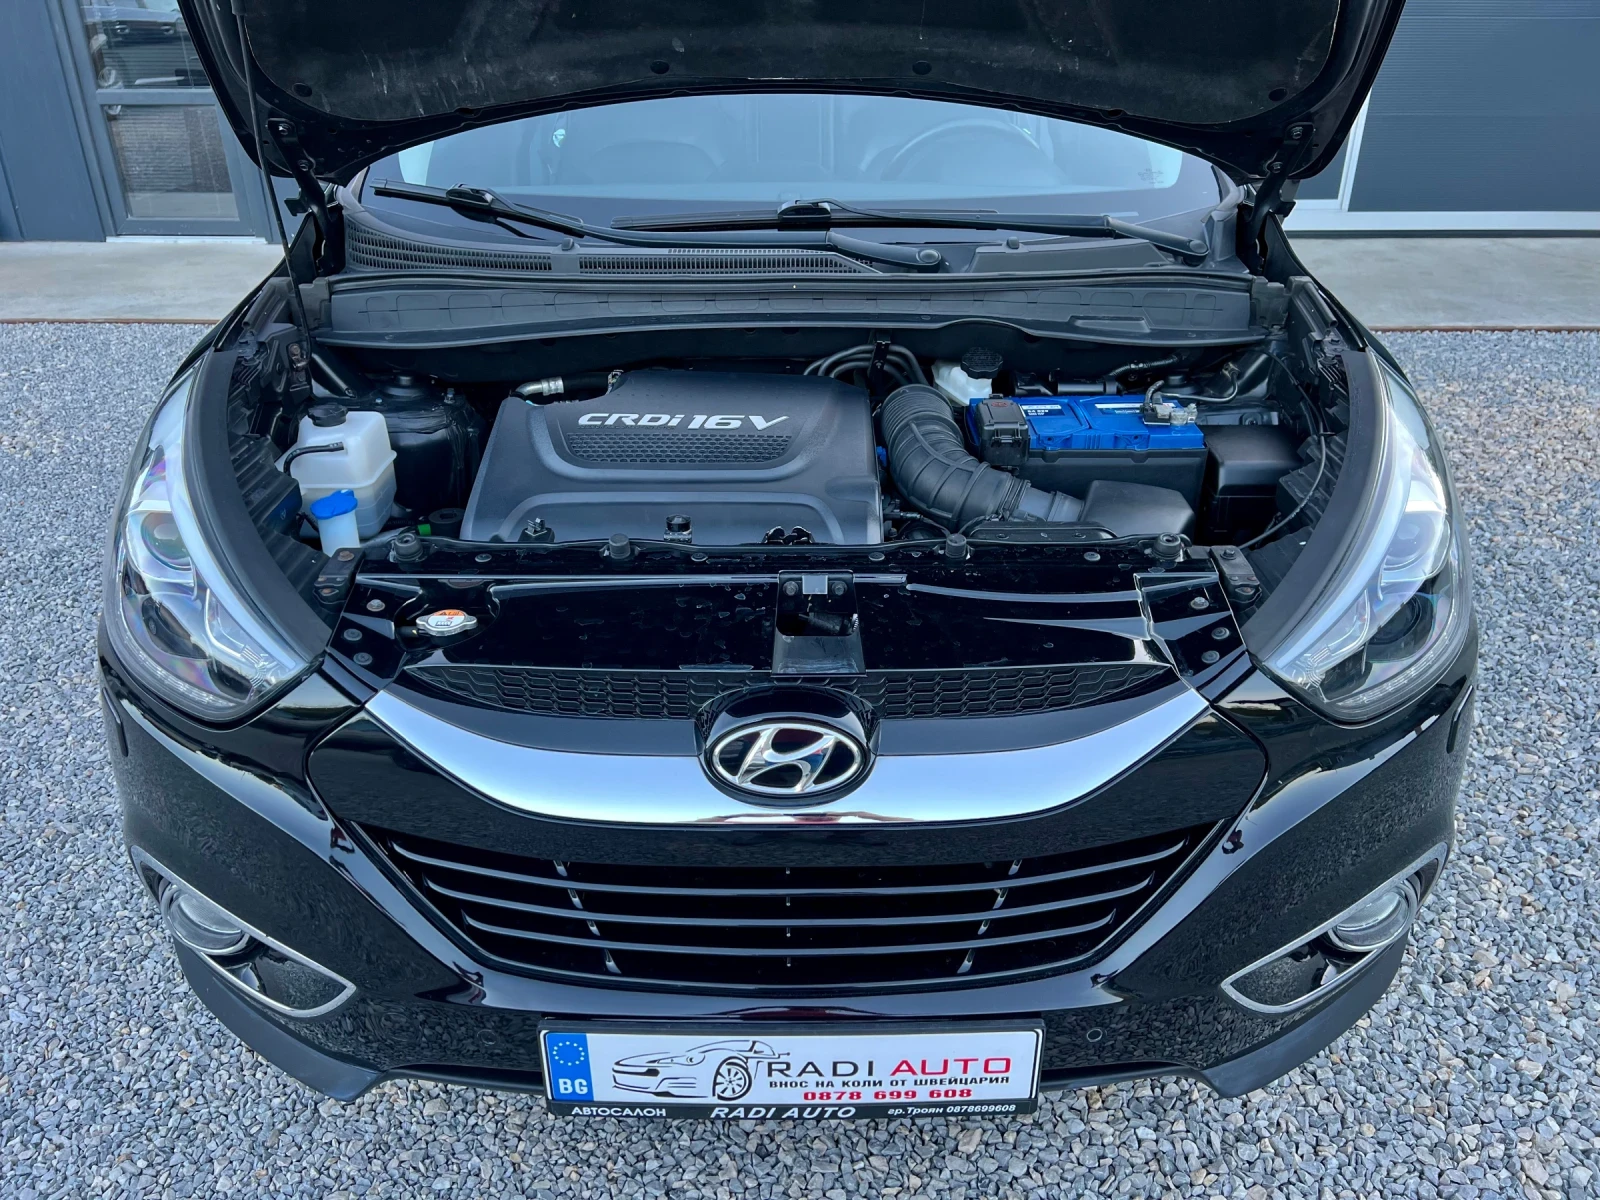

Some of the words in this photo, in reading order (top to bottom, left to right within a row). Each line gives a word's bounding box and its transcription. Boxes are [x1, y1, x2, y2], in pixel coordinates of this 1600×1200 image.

[577, 413, 685, 428] CRDi
[766, 1060, 875, 1078] RADI
[889, 1057, 1012, 1077] AUTO
[558, 1078, 588, 1095] BG
[769, 1080, 809, 1089] ВНОС
[815, 1080, 835, 1089] НА
[841, 1079, 883, 1088] КОЛИ
[889, 1079, 908, 1088] ОТ
[913, 1076, 1010, 1086] ШВЕЙЦАРИЯ
[803, 1091, 863, 1101] 0878
[873, 1090, 918, 1100] 699
[928, 1088, 973, 1099] 608
[571, 1106, 667, 1117] АВТОСАЛОН
[710, 1107, 777, 1119] RADI
[781, 1107, 857, 1119] AUTO
[946, 1104, 1017, 1114] 0878699608
